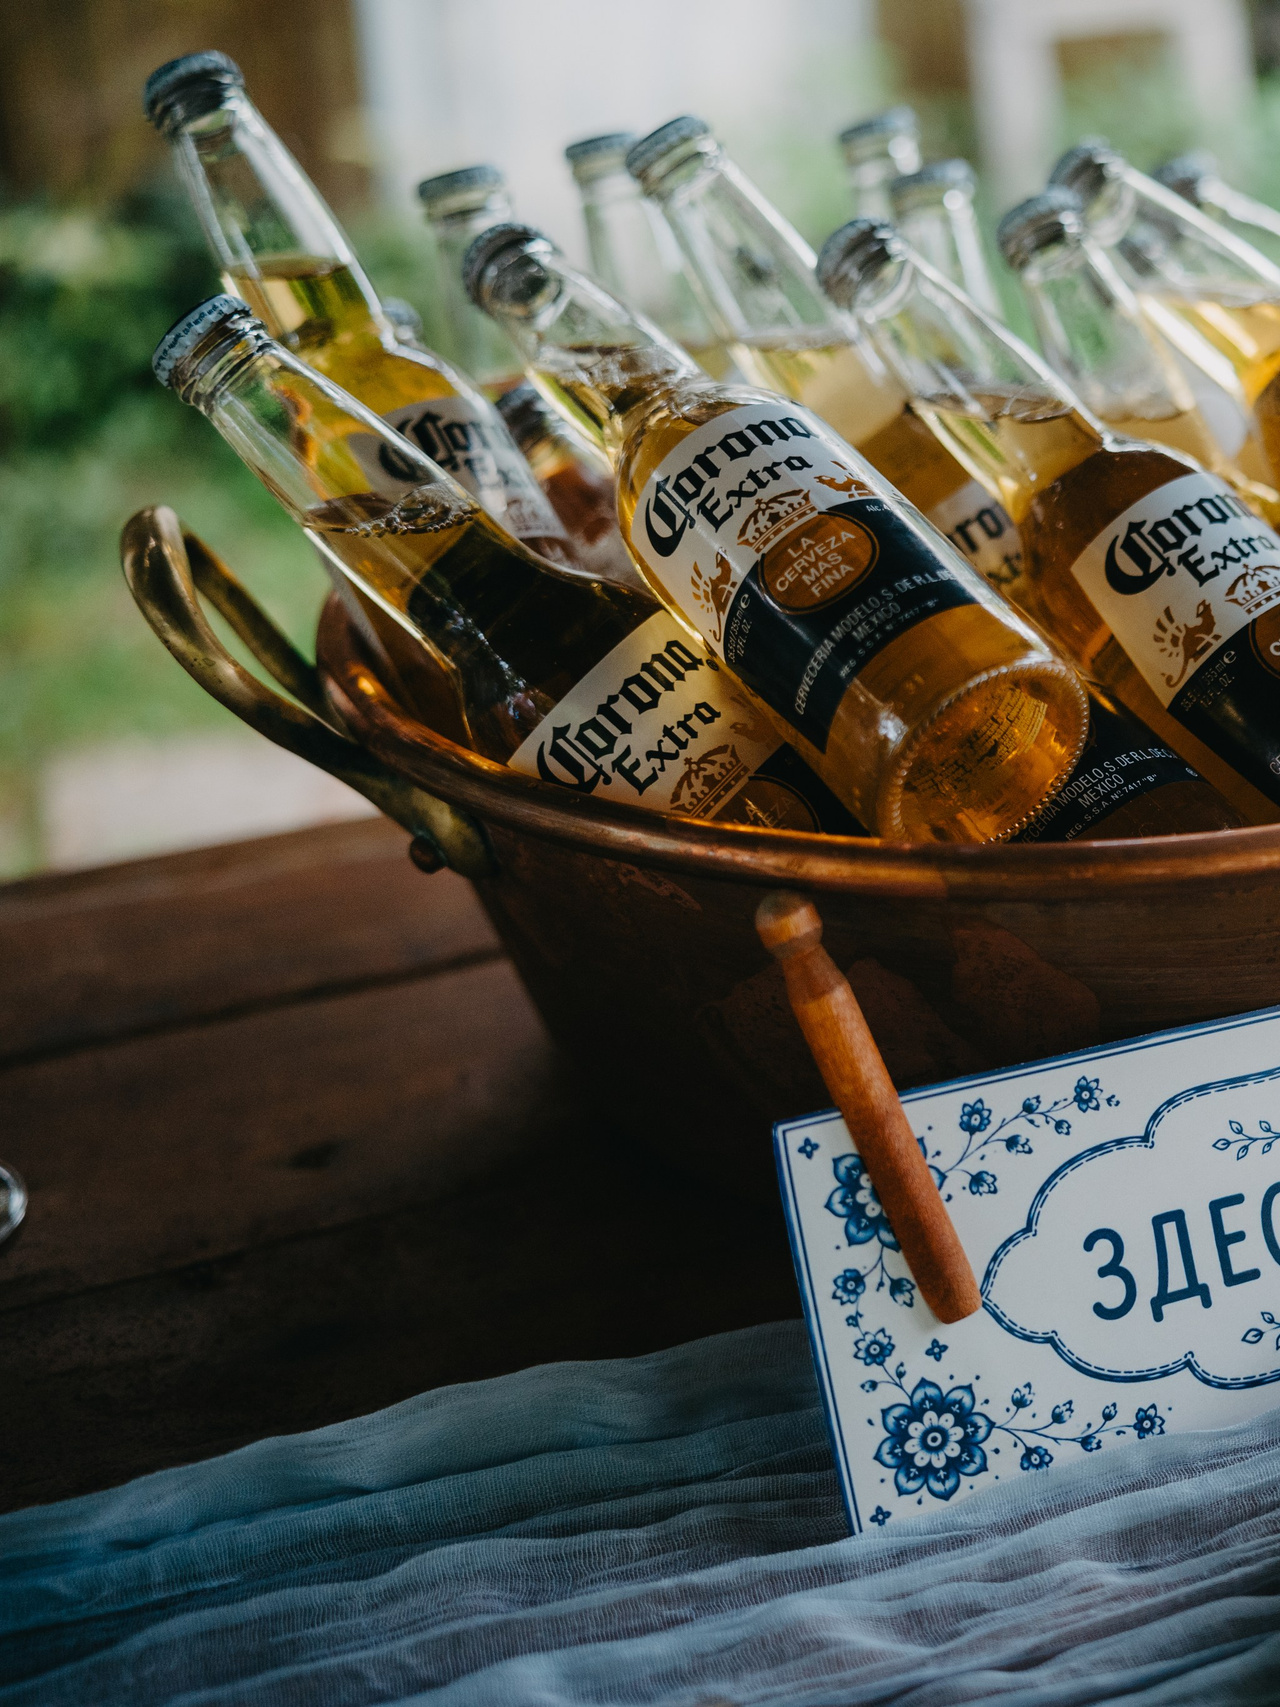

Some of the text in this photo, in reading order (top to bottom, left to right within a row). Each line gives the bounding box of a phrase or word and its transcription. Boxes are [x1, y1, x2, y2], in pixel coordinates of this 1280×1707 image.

[645, 417, 819, 557] Corona
[697, 456, 813, 533] Extra
[775, 530, 855, 592] CERVEZA
[787, 536, 815, 559] LA
[801, 553, 843, 586] MAS
[1178, 536, 1277, 588] Extra
[811, 564, 854, 597] FINA
[852, 602, 901, 642] MEXICO
[795, 638, 836, 715] CERVECERIA
[894, 578, 916, 593] DE
[537, 639, 705, 794] Corona
[612, 701, 722, 796] Extra
[1115, 753, 1134, 767] DE
[1078, 773, 1125, 809] MEXICO
[1122, 780, 1142, 793] 7417
